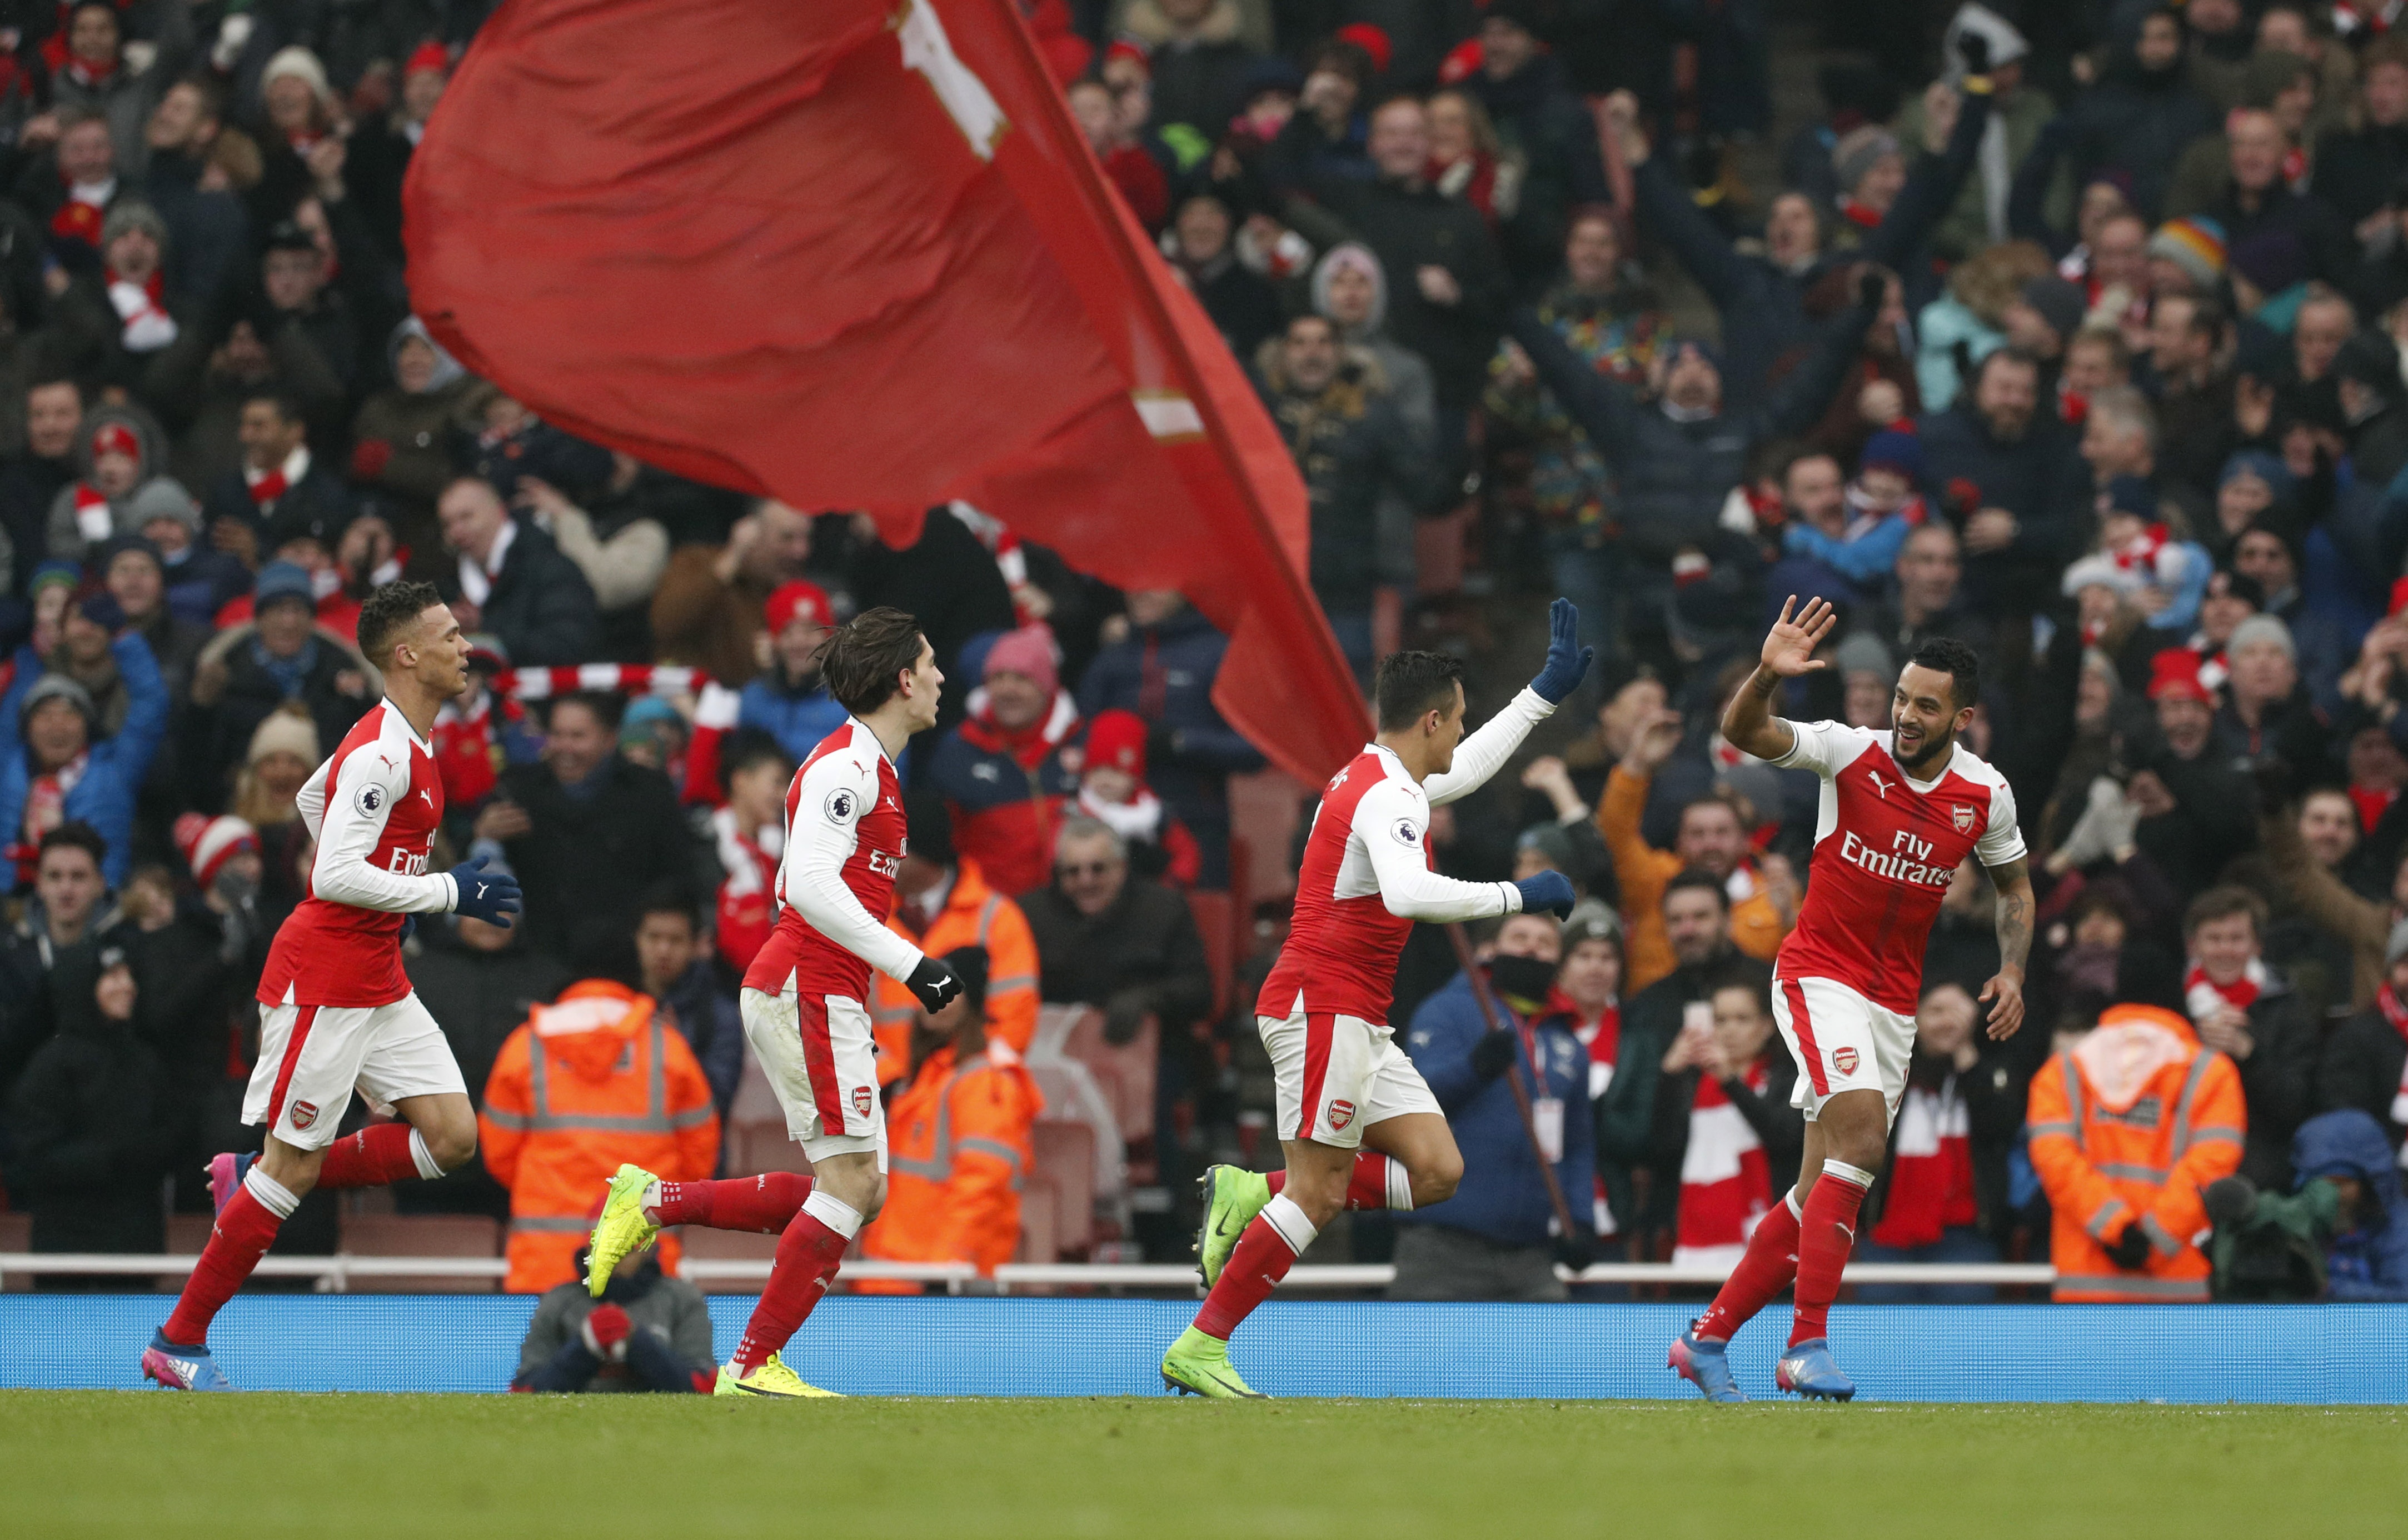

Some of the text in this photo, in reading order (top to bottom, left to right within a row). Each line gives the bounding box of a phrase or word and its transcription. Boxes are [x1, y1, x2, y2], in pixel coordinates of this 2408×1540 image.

[1841, 830, 1955, 885] Emirate
[1893, 830, 1933, 861] Fly
[1333, 1103, 1353, 1113] Arsenal
[167, 1359, 193, 1391] adidas
